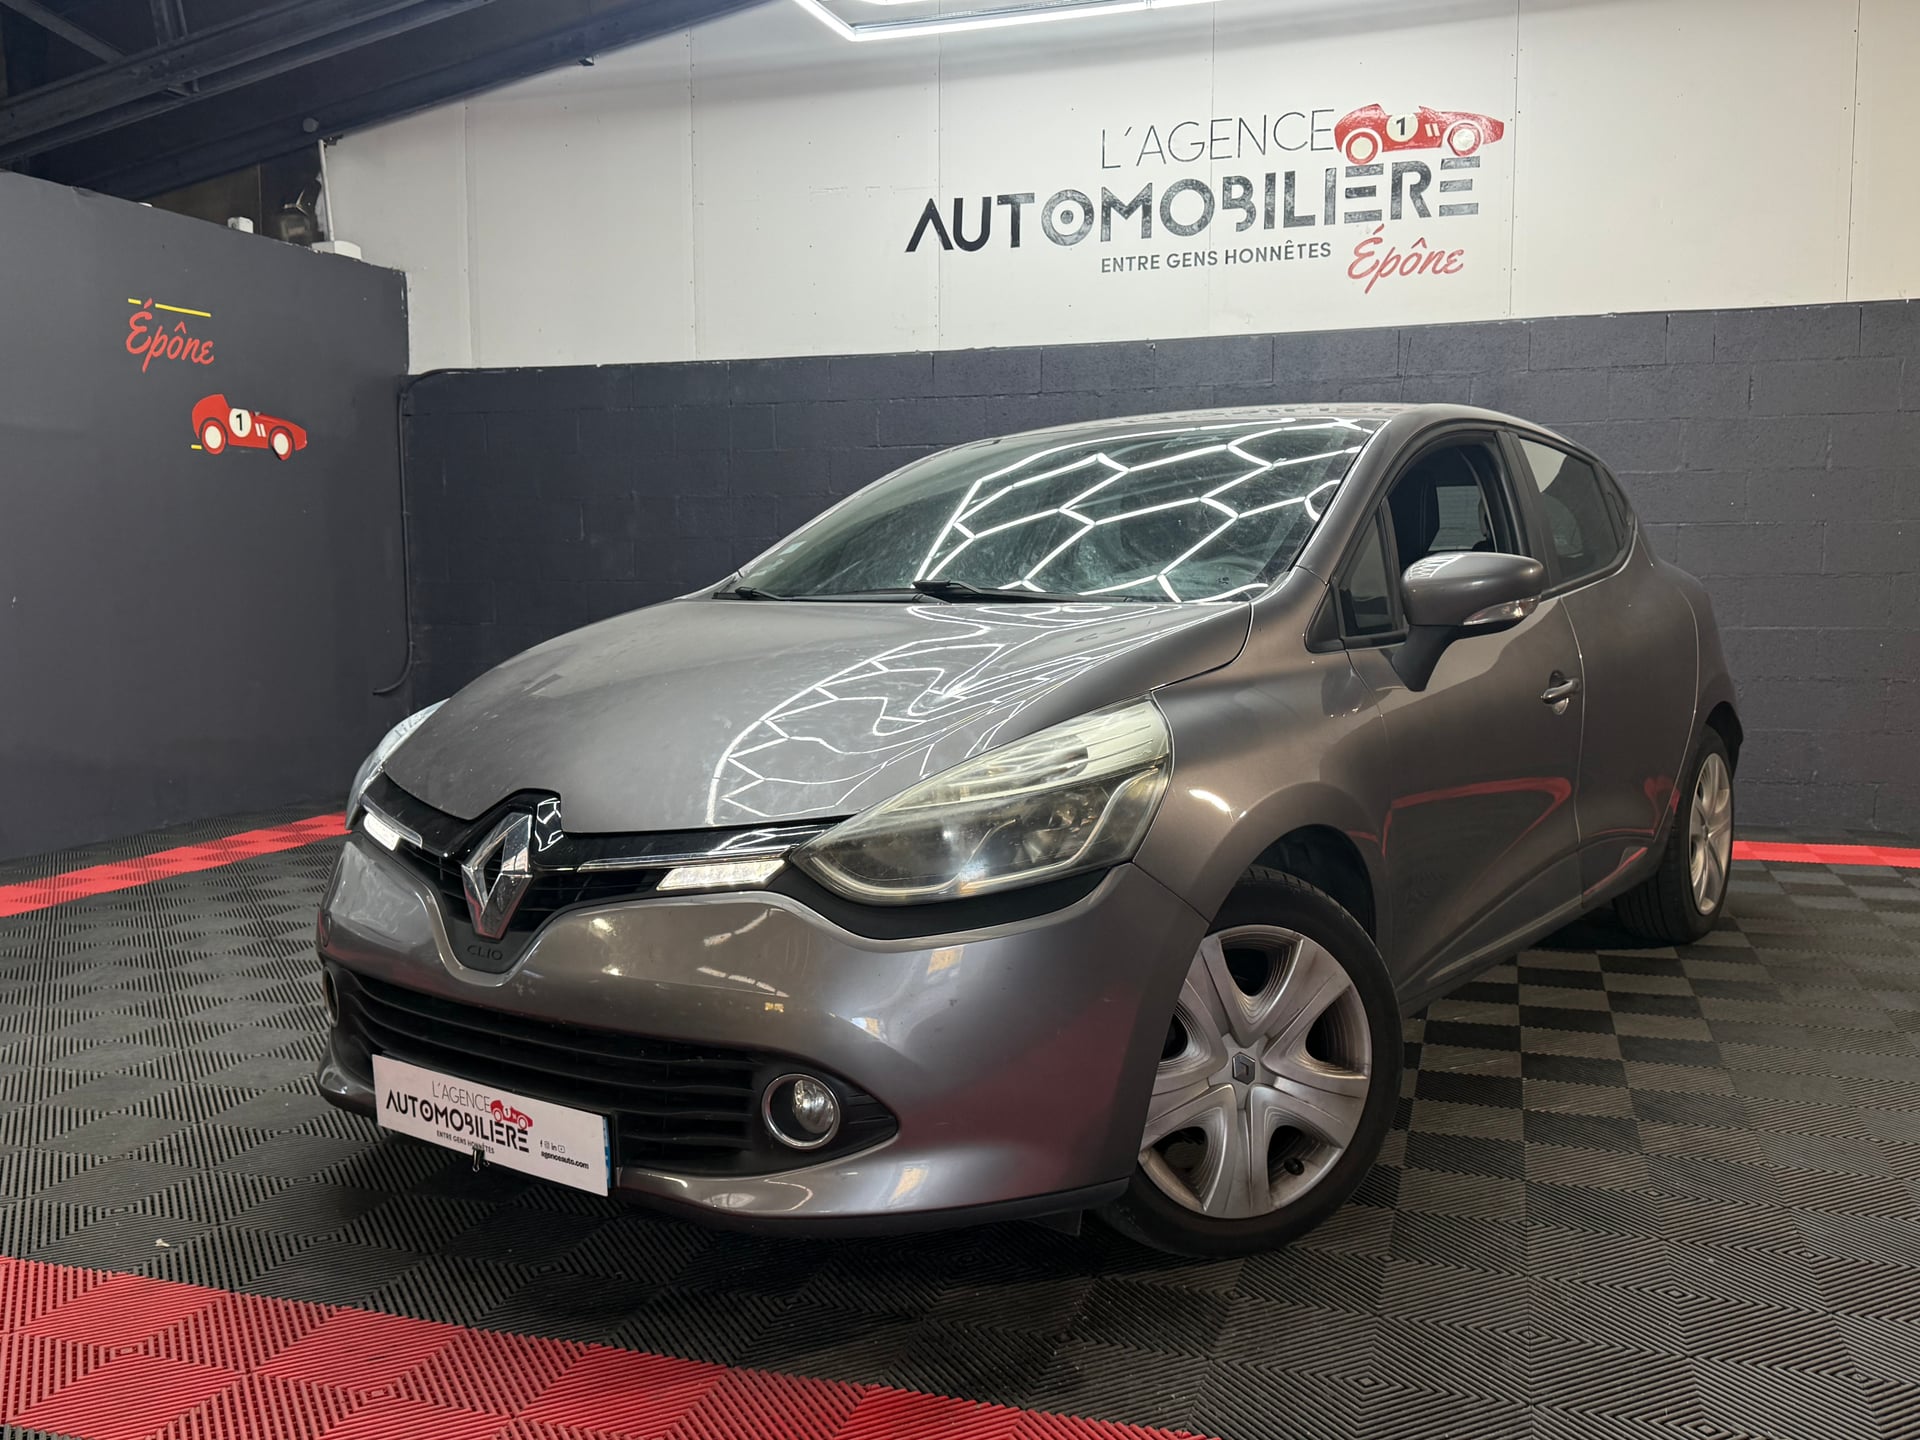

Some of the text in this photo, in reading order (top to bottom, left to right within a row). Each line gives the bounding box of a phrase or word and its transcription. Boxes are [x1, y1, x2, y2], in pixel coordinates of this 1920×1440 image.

[1100, 108, 1335, 170] L'AGENCE
[1395, 116, 1406, 136] 1
[1100, 239, 1332, 274] ENTRE GENS HONNÊTES
[1346, 224, 1465, 294] Épône
[125, 297, 215, 374] Épône
[235, 412, 244, 432] 1
[466, 944, 504, 961] CLIO
[432, 1080, 492, 1114] L'AGENCE
[436, 1129, 452, 1141] ENTRE
[453, 1135, 467, 1146] GENS
